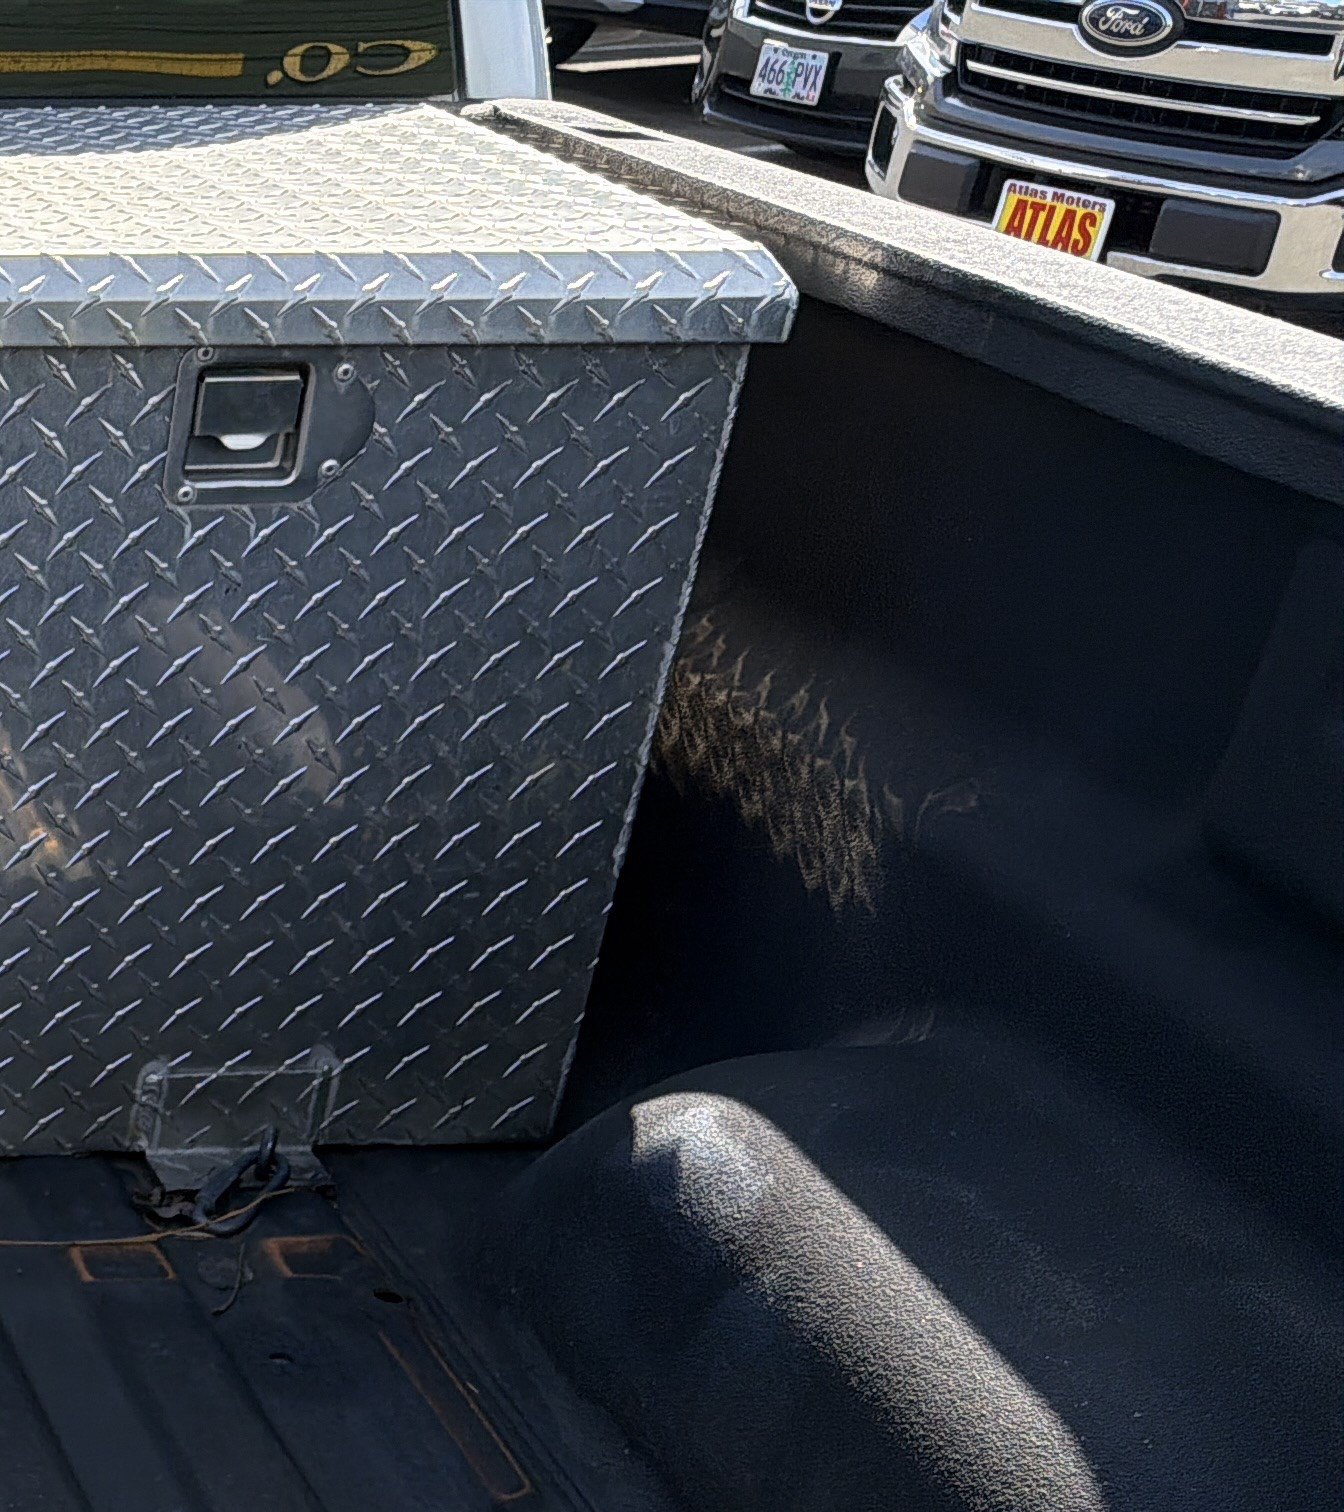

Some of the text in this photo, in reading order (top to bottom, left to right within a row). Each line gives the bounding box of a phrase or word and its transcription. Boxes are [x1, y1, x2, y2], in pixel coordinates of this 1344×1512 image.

[1098, 6, 1150, 36] Ford
[1007, 183, 1107, 213] Atlas Motors
[1002, 197, 1097, 257] ATLAS
